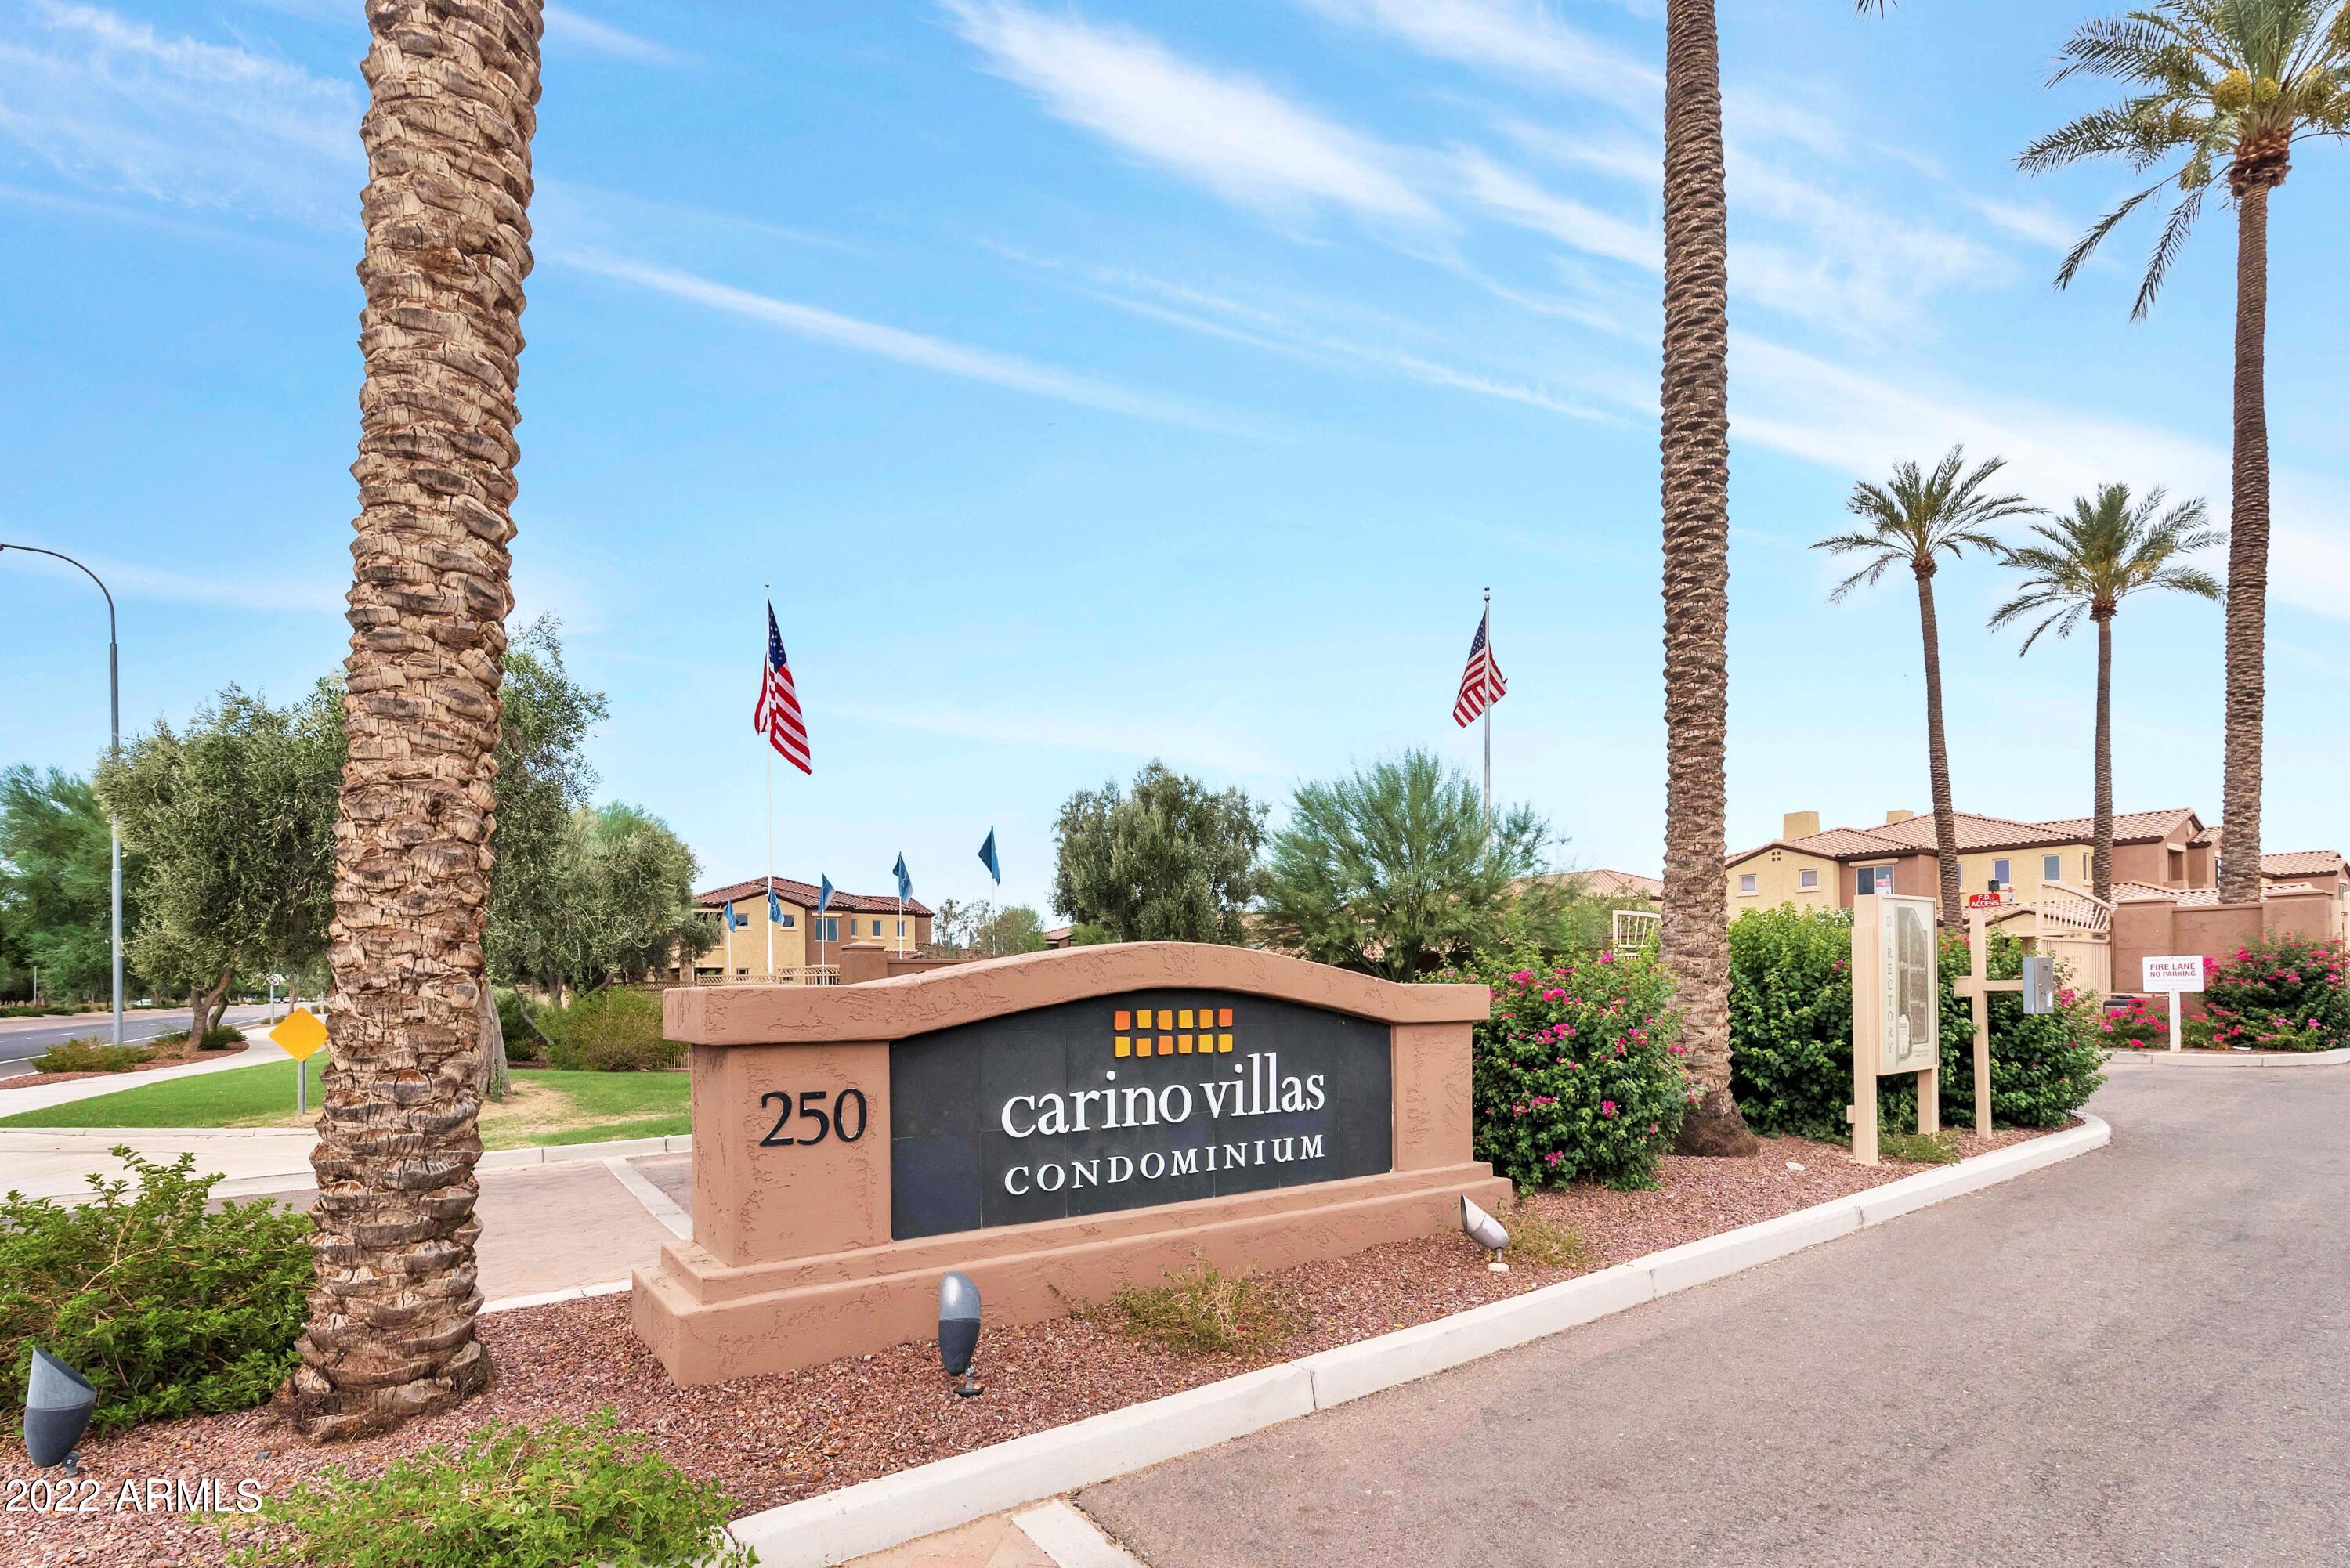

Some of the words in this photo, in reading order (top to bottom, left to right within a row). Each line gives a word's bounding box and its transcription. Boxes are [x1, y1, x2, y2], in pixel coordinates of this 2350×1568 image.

[758, 1087, 867, 1147] 250
[1001, 1070, 1193, 1139] carino
[1199, 1052, 1325, 1119] villas
[1004, 1134, 1325, 1196] CONDOMINIUM
